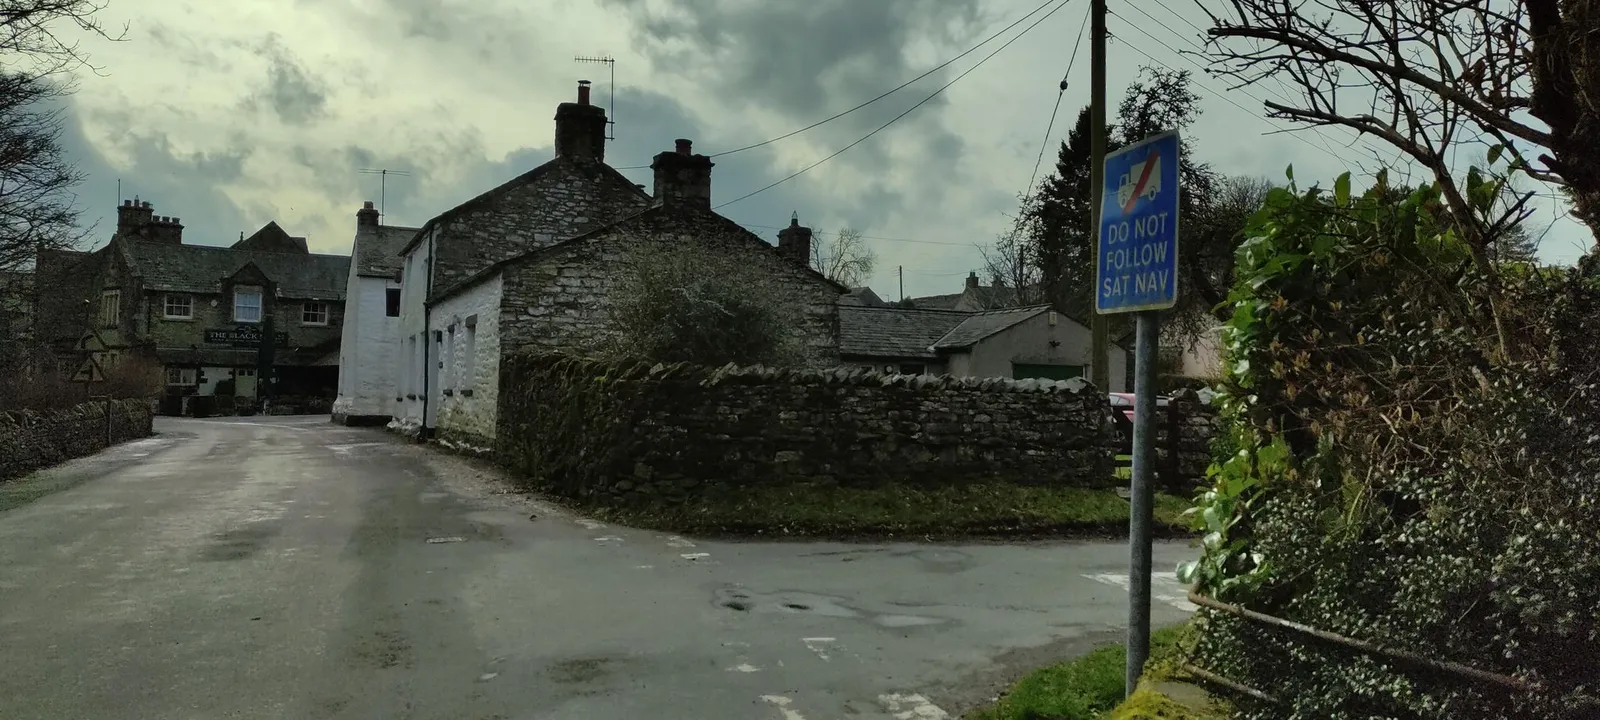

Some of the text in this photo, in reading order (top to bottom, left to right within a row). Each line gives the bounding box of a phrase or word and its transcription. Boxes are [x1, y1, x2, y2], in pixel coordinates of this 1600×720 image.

[1108, 212, 1168, 245] DO NOT
[1106, 241, 1168, 271] FOLLOW
[1103, 268, 1168, 298] SAT NAV
[229, 332, 257, 340] BLACK
